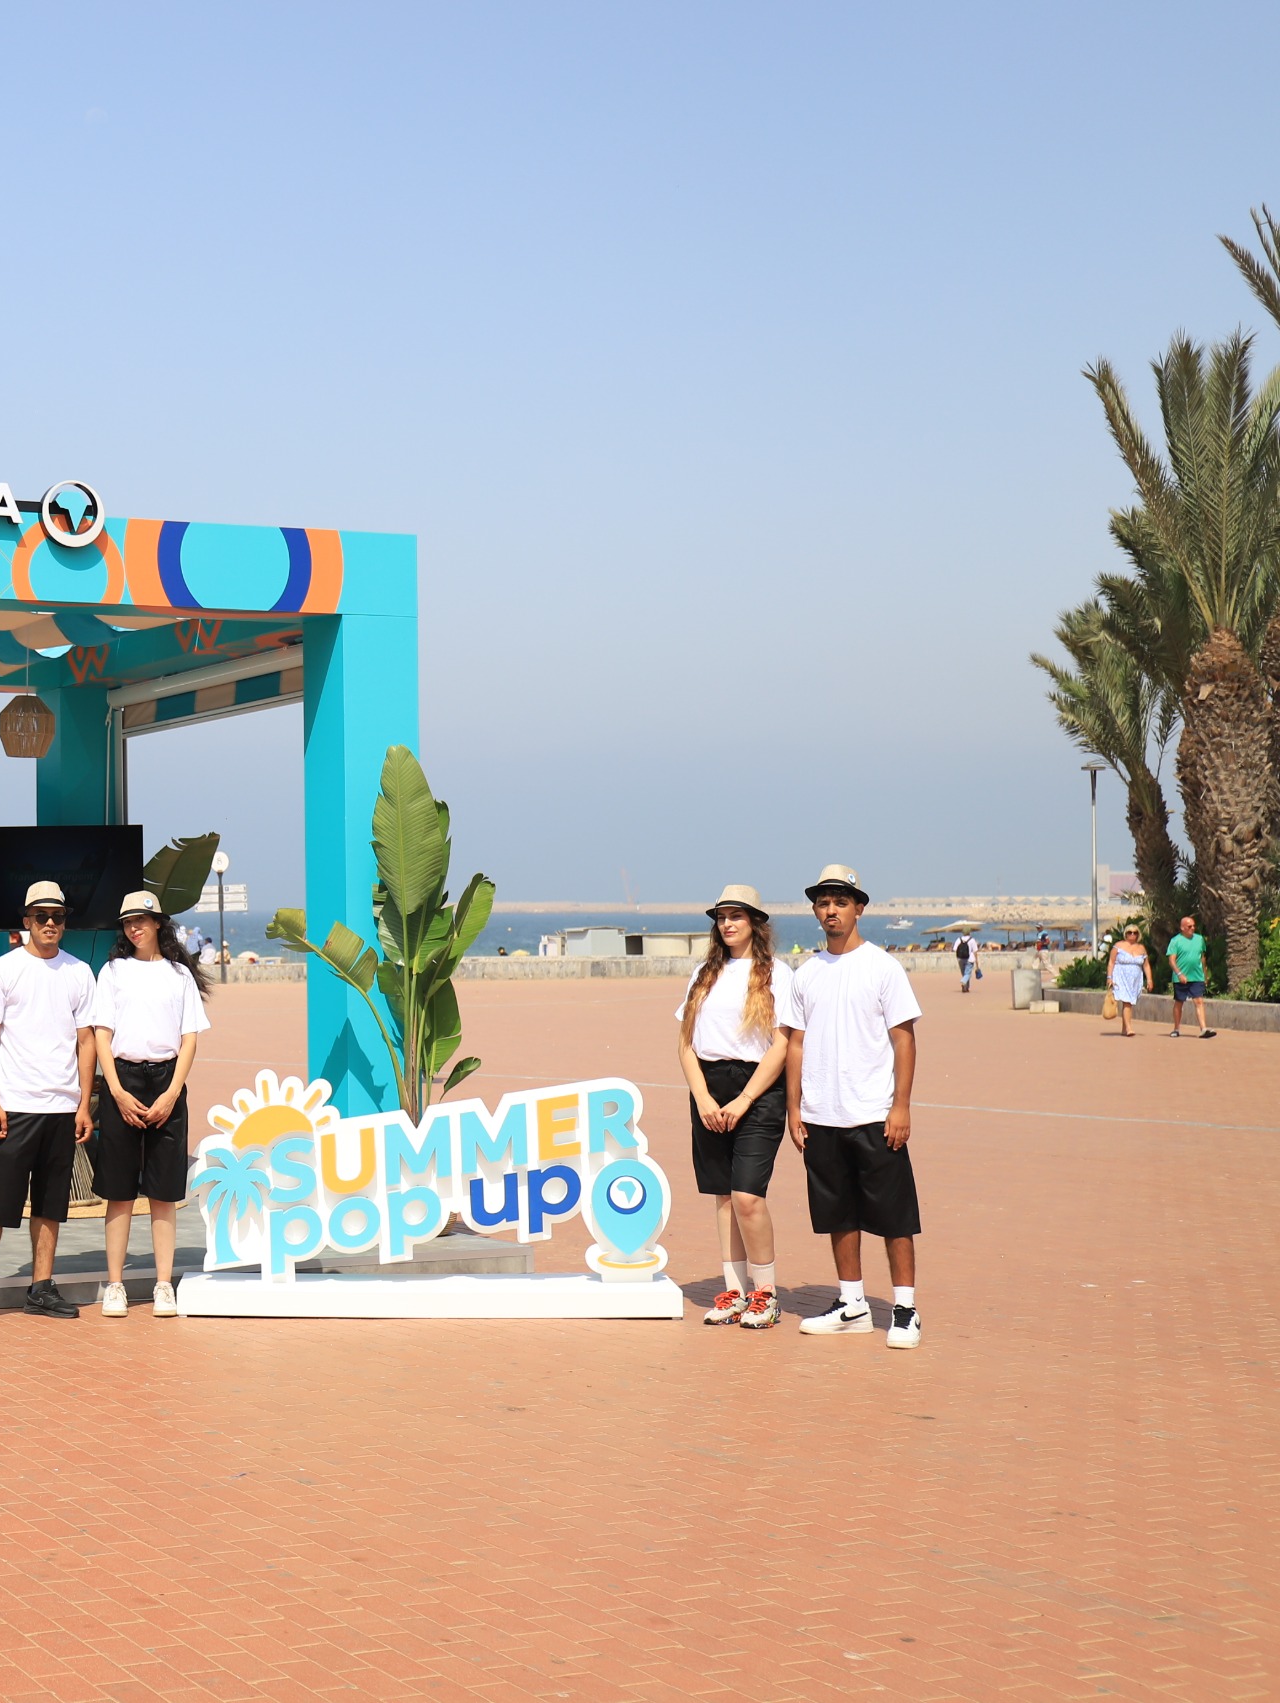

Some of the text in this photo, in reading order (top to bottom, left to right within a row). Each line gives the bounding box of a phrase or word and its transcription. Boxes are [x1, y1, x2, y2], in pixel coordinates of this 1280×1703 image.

[269, 1088, 639, 1203] SUMMER
[269, 1164, 582, 1275] pop up
